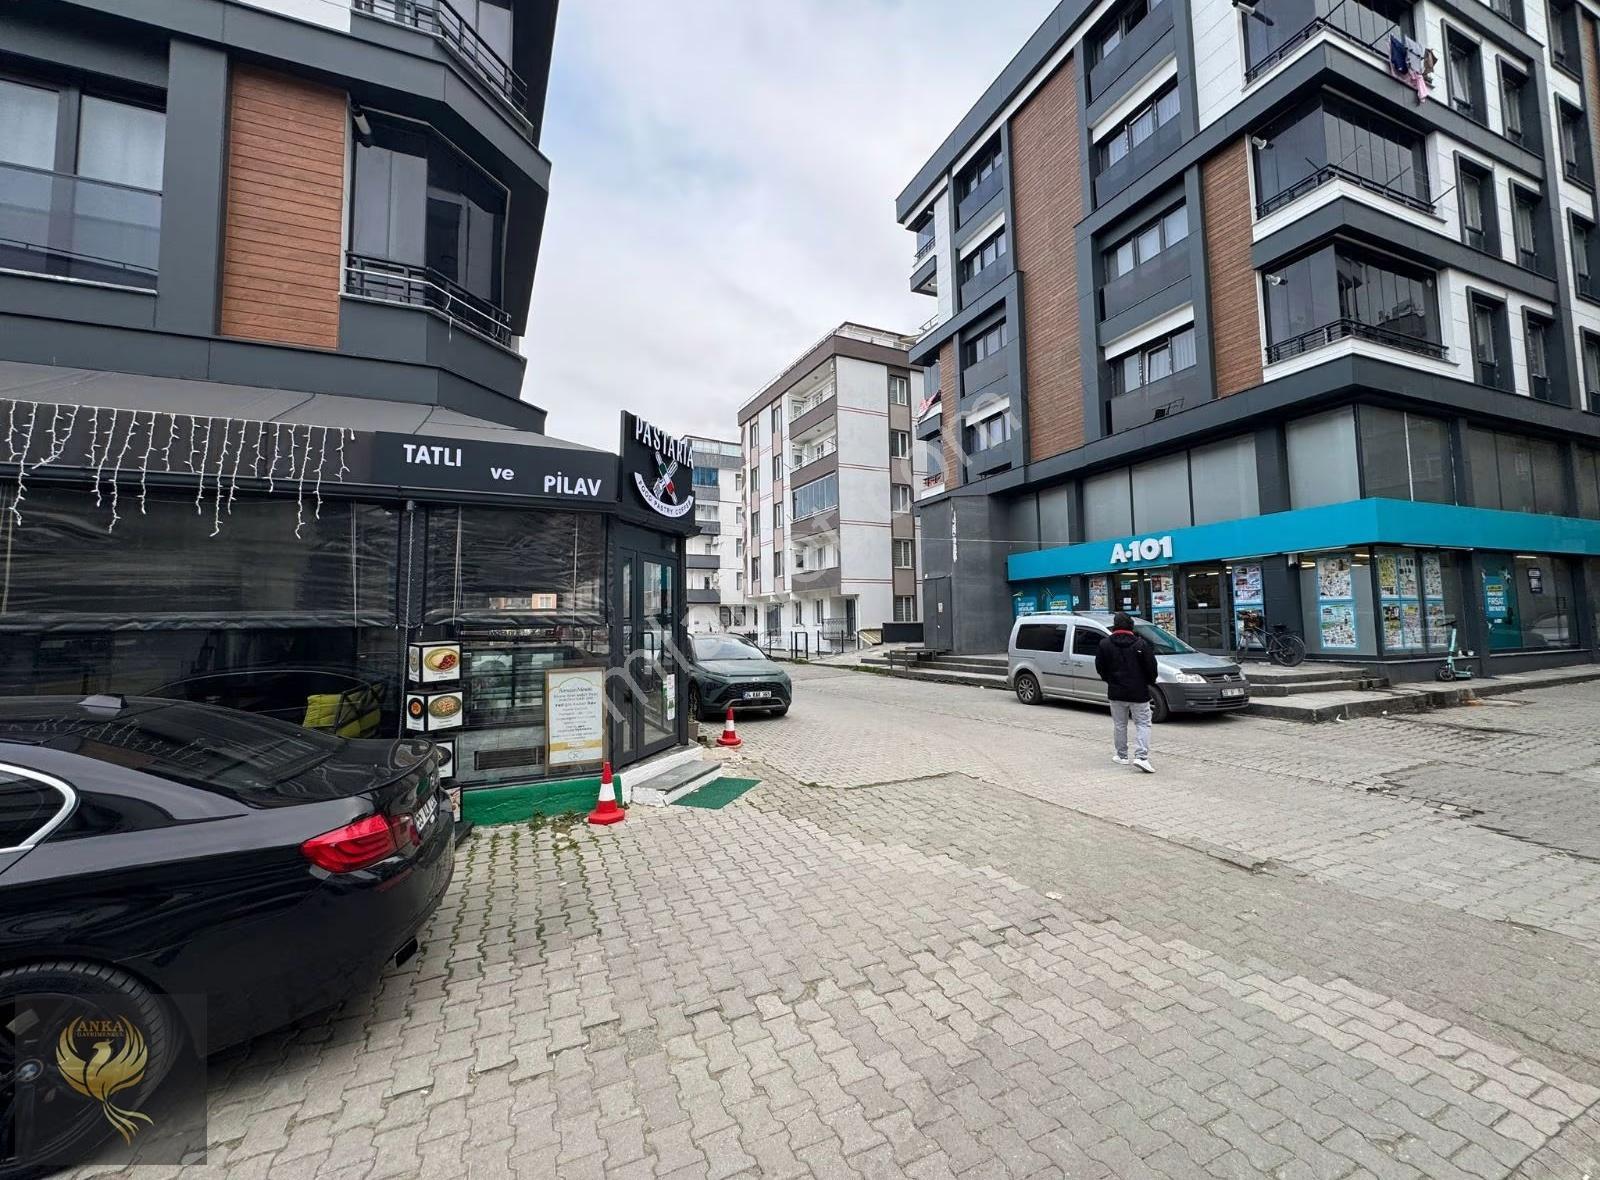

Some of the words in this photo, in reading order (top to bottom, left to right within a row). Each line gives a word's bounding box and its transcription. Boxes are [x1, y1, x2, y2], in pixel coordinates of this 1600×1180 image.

[635, 415, 694, 470] PASTARIA
[403, 443, 462, 467] TATLI
[490, 467, 515, 480] ve
[543, 472, 602, 496] PİLAV
[654, 501, 674, 515] PASTRY
